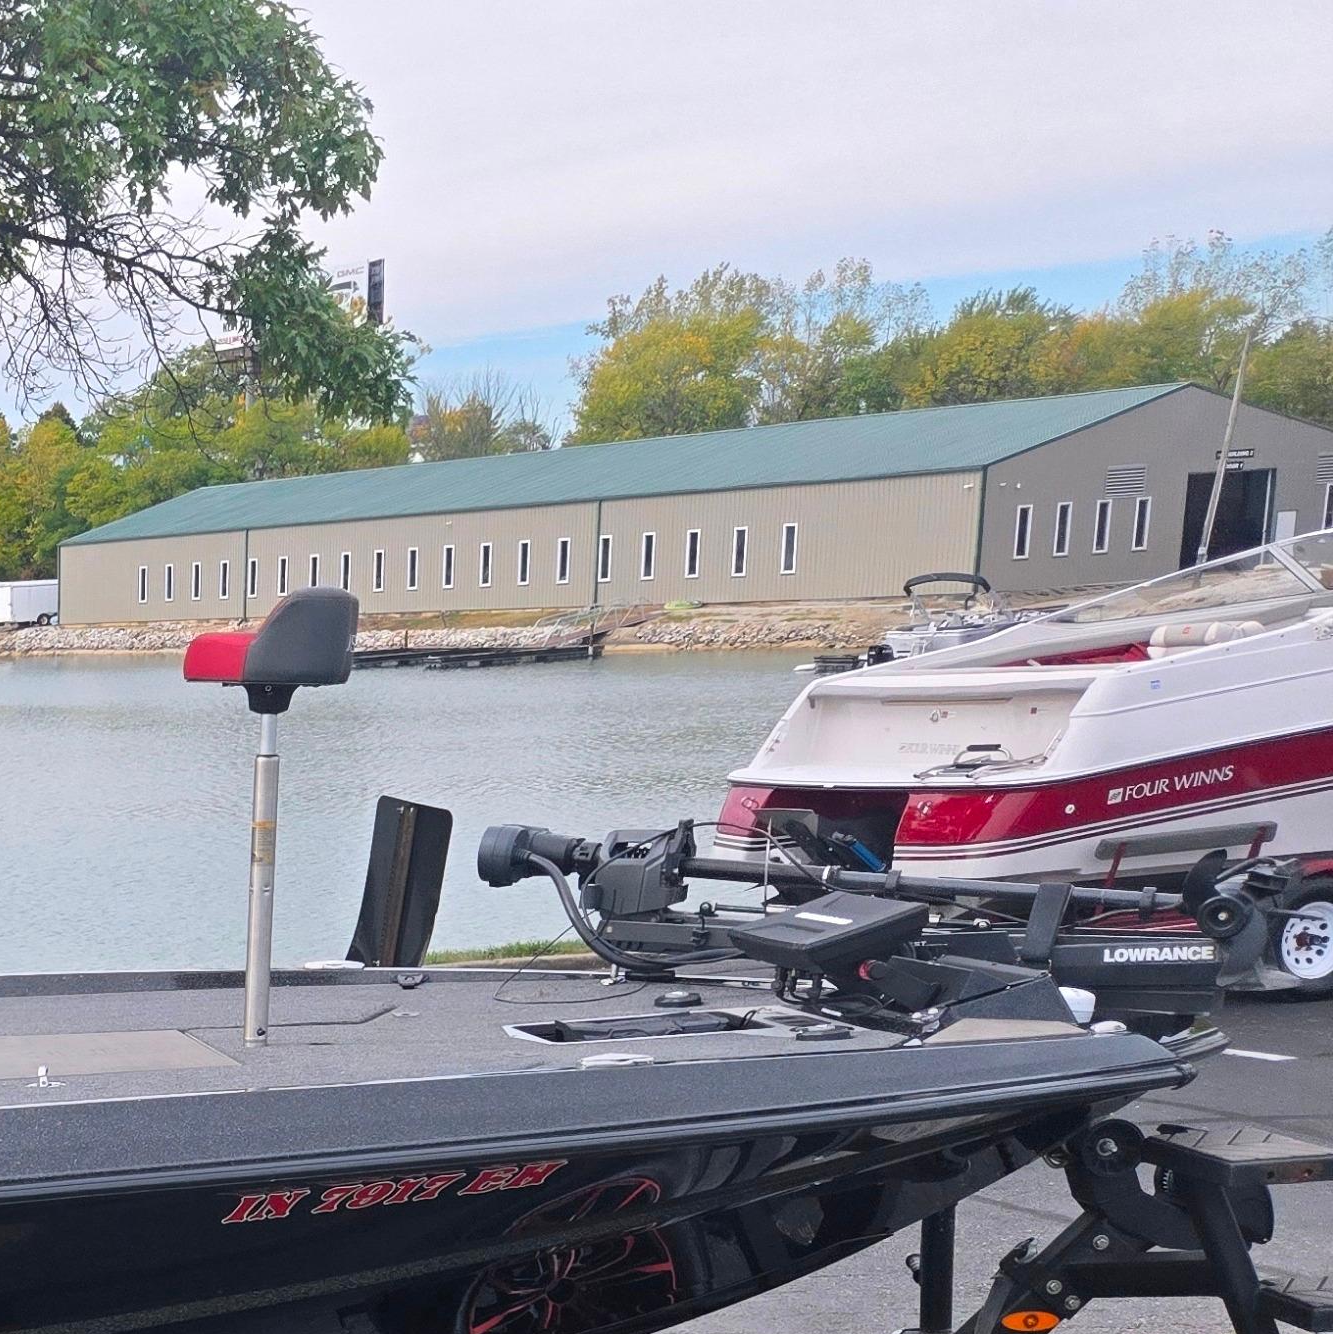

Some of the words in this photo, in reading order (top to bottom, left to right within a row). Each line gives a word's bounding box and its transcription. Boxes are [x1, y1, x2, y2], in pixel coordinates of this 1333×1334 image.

[337, 266, 365, 279] GMC
[1124, 778, 1170, 801] FOUR
[1173, 765, 1235, 791] WINNS
[1102, 945, 1215, 963] LOWRANCE
[221, 1189, 311, 1224] IN
[311, 1172, 467, 1214] 7917
[457, 1159, 569, 1196] EH
